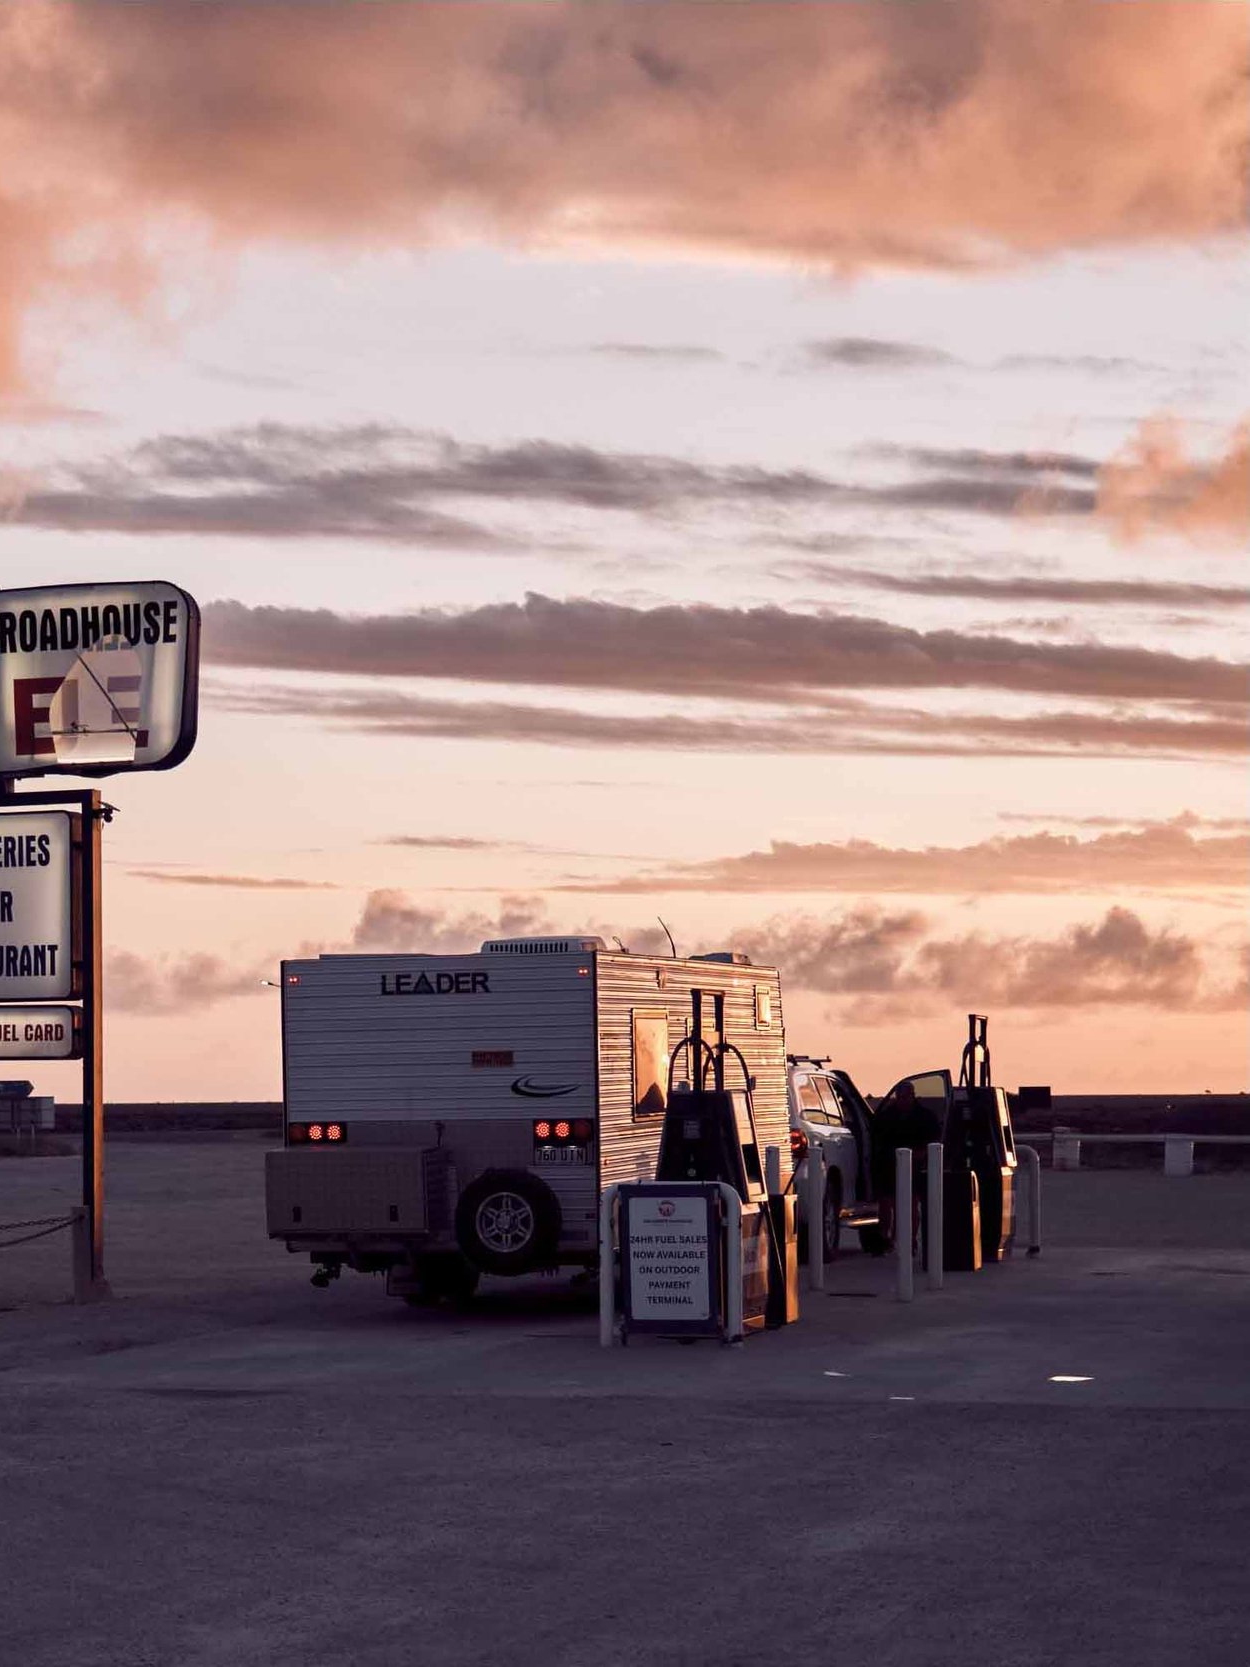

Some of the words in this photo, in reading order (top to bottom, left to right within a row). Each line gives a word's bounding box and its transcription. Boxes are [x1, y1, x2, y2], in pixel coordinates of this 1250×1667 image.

[0, 601, 178, 654] ROADHOUSE
[381, 970, 491, 995] LEADER
[24, 1023, 64, 1041] CARD
[629, 1235, 653, 1244] 24HR
[655, 1235, 677, 1244] FUEL
[679, 1235, 708, 1244] SALES
[633, 1251, 655, 1259] NOW
[656, 1251, 706, 1259] AVAILABLE
[639, 1266, 653, 1274] ON
[654, 1266, 700, 1274] OUTDOOR
[648, 1281, 691, 1289] PAYMENT
[647, 1296, 694, 1304] TERMINAL
